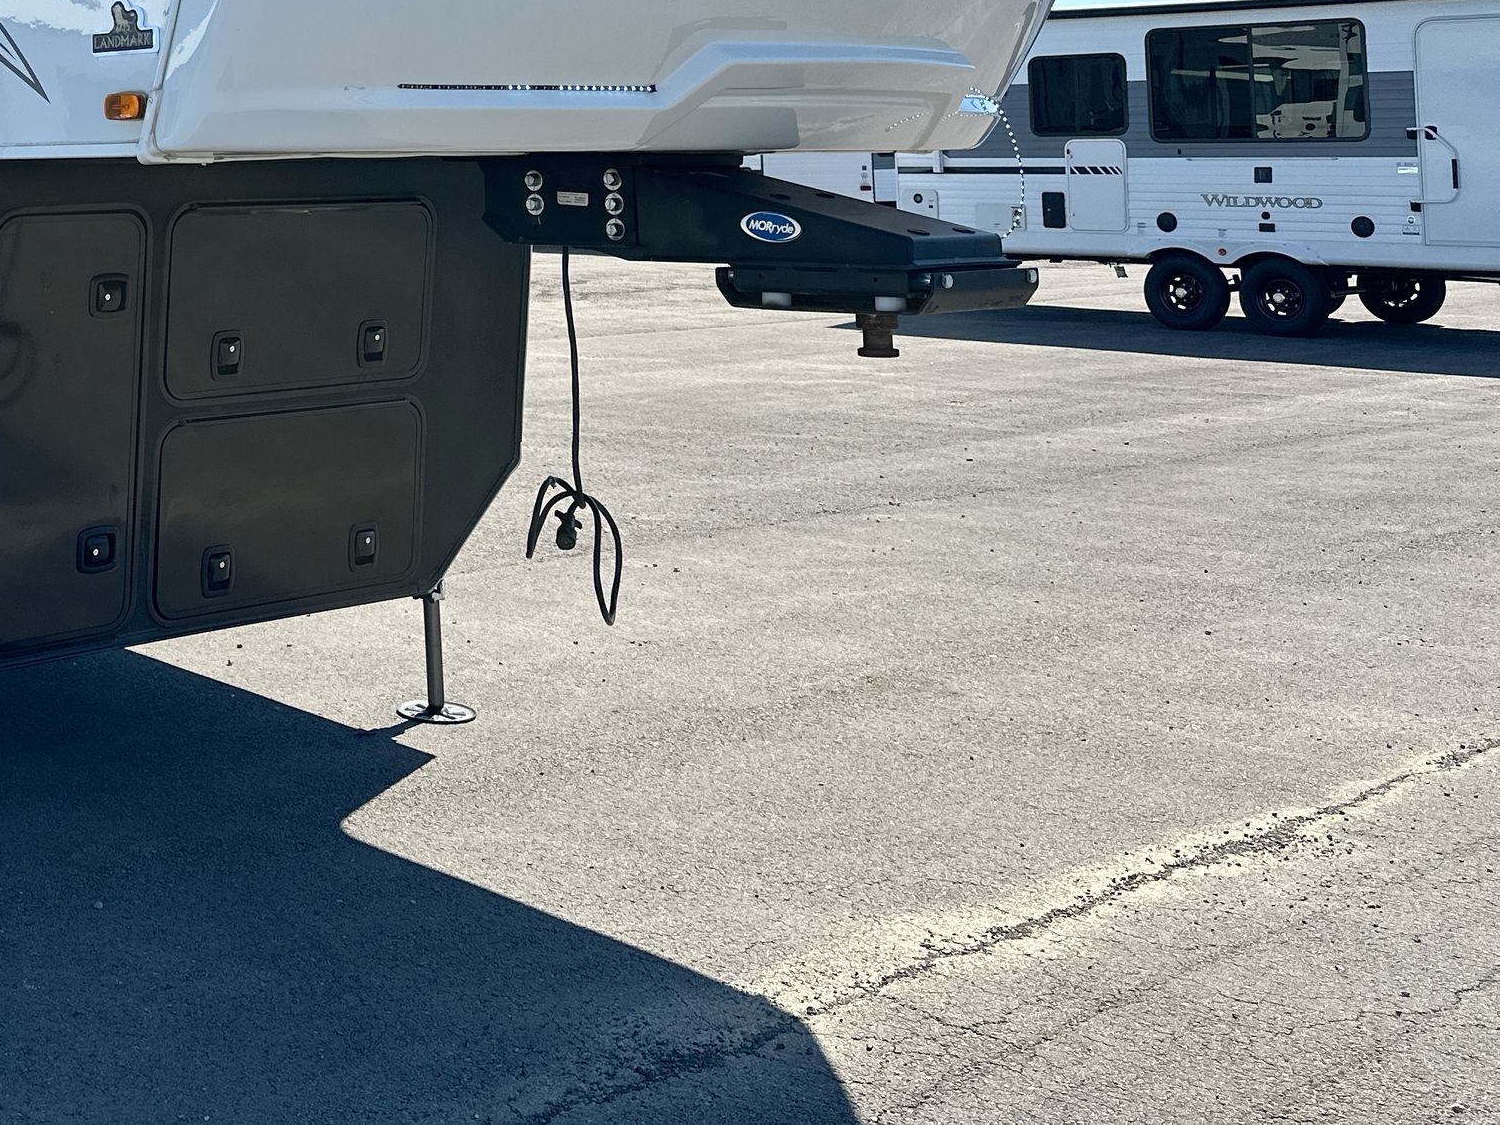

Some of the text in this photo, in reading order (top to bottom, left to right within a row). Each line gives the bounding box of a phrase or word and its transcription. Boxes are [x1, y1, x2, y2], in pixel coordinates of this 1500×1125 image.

[94, 33, 150, 49] LANDMARK
[1201, 194, 1323, 208] WILDWOOD
[749, 219, 794, 234] MORryde
